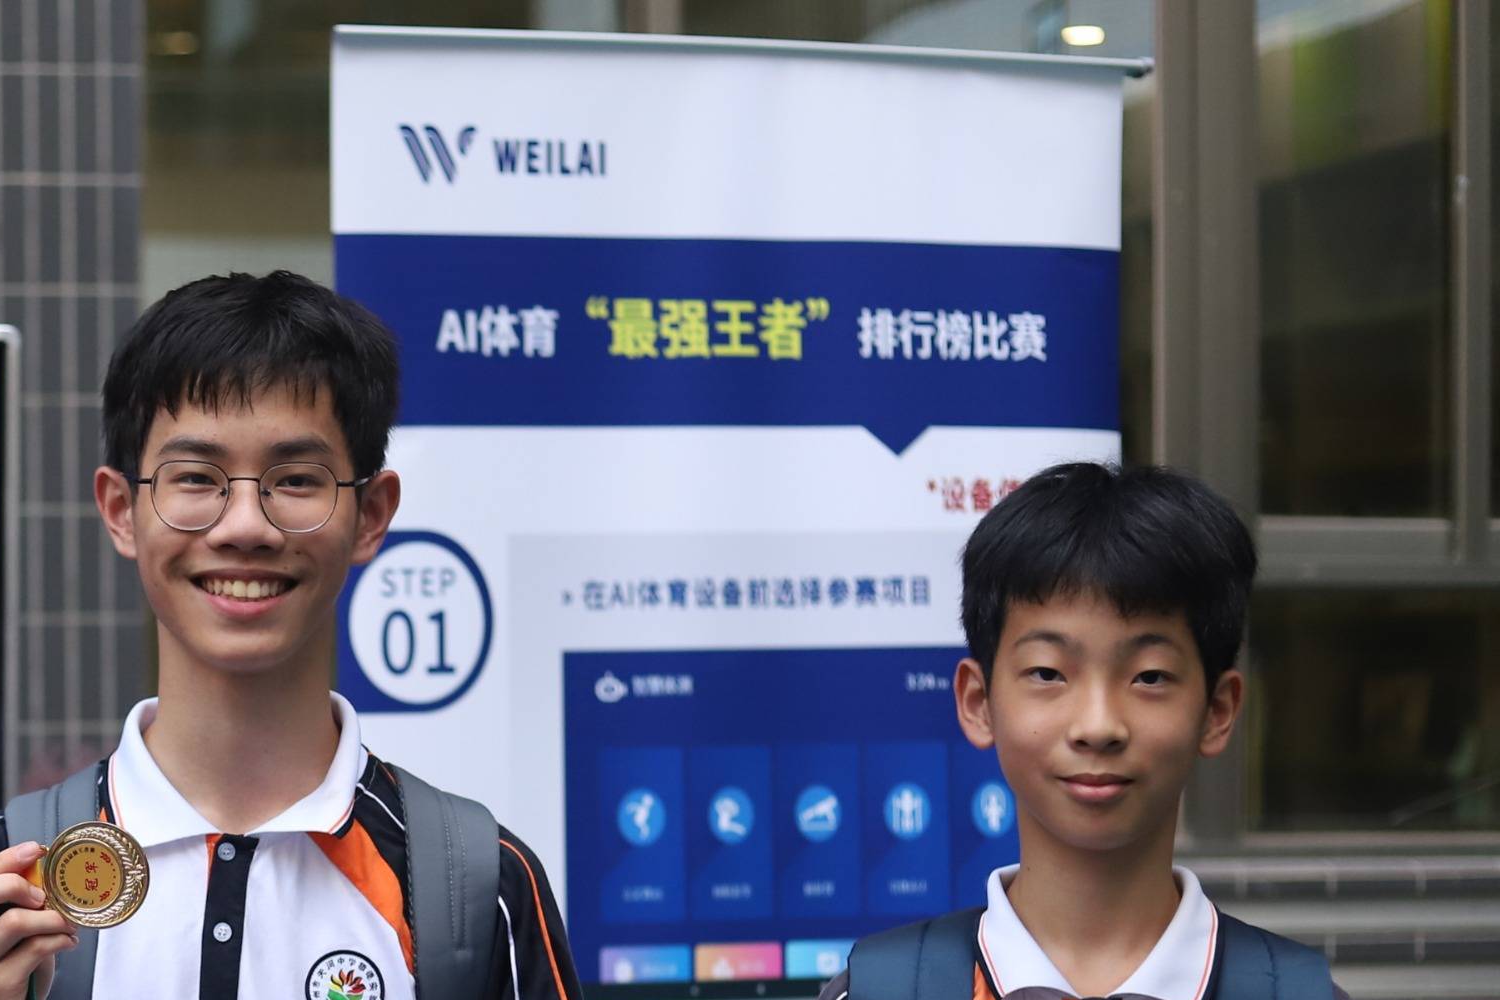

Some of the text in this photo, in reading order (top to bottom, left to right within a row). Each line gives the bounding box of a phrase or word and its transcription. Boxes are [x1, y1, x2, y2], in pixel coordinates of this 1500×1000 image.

[493, 139, 607, 176] WEILAI
[436, 296, 1048, 362] AI体育 “最强王者” 排行榜比赛
[381, 568, 457, 598] STEP
[583, 575, 931, 611] 在AI体育设备前选择参赛项目
[383, 609, 455, 675] 01
